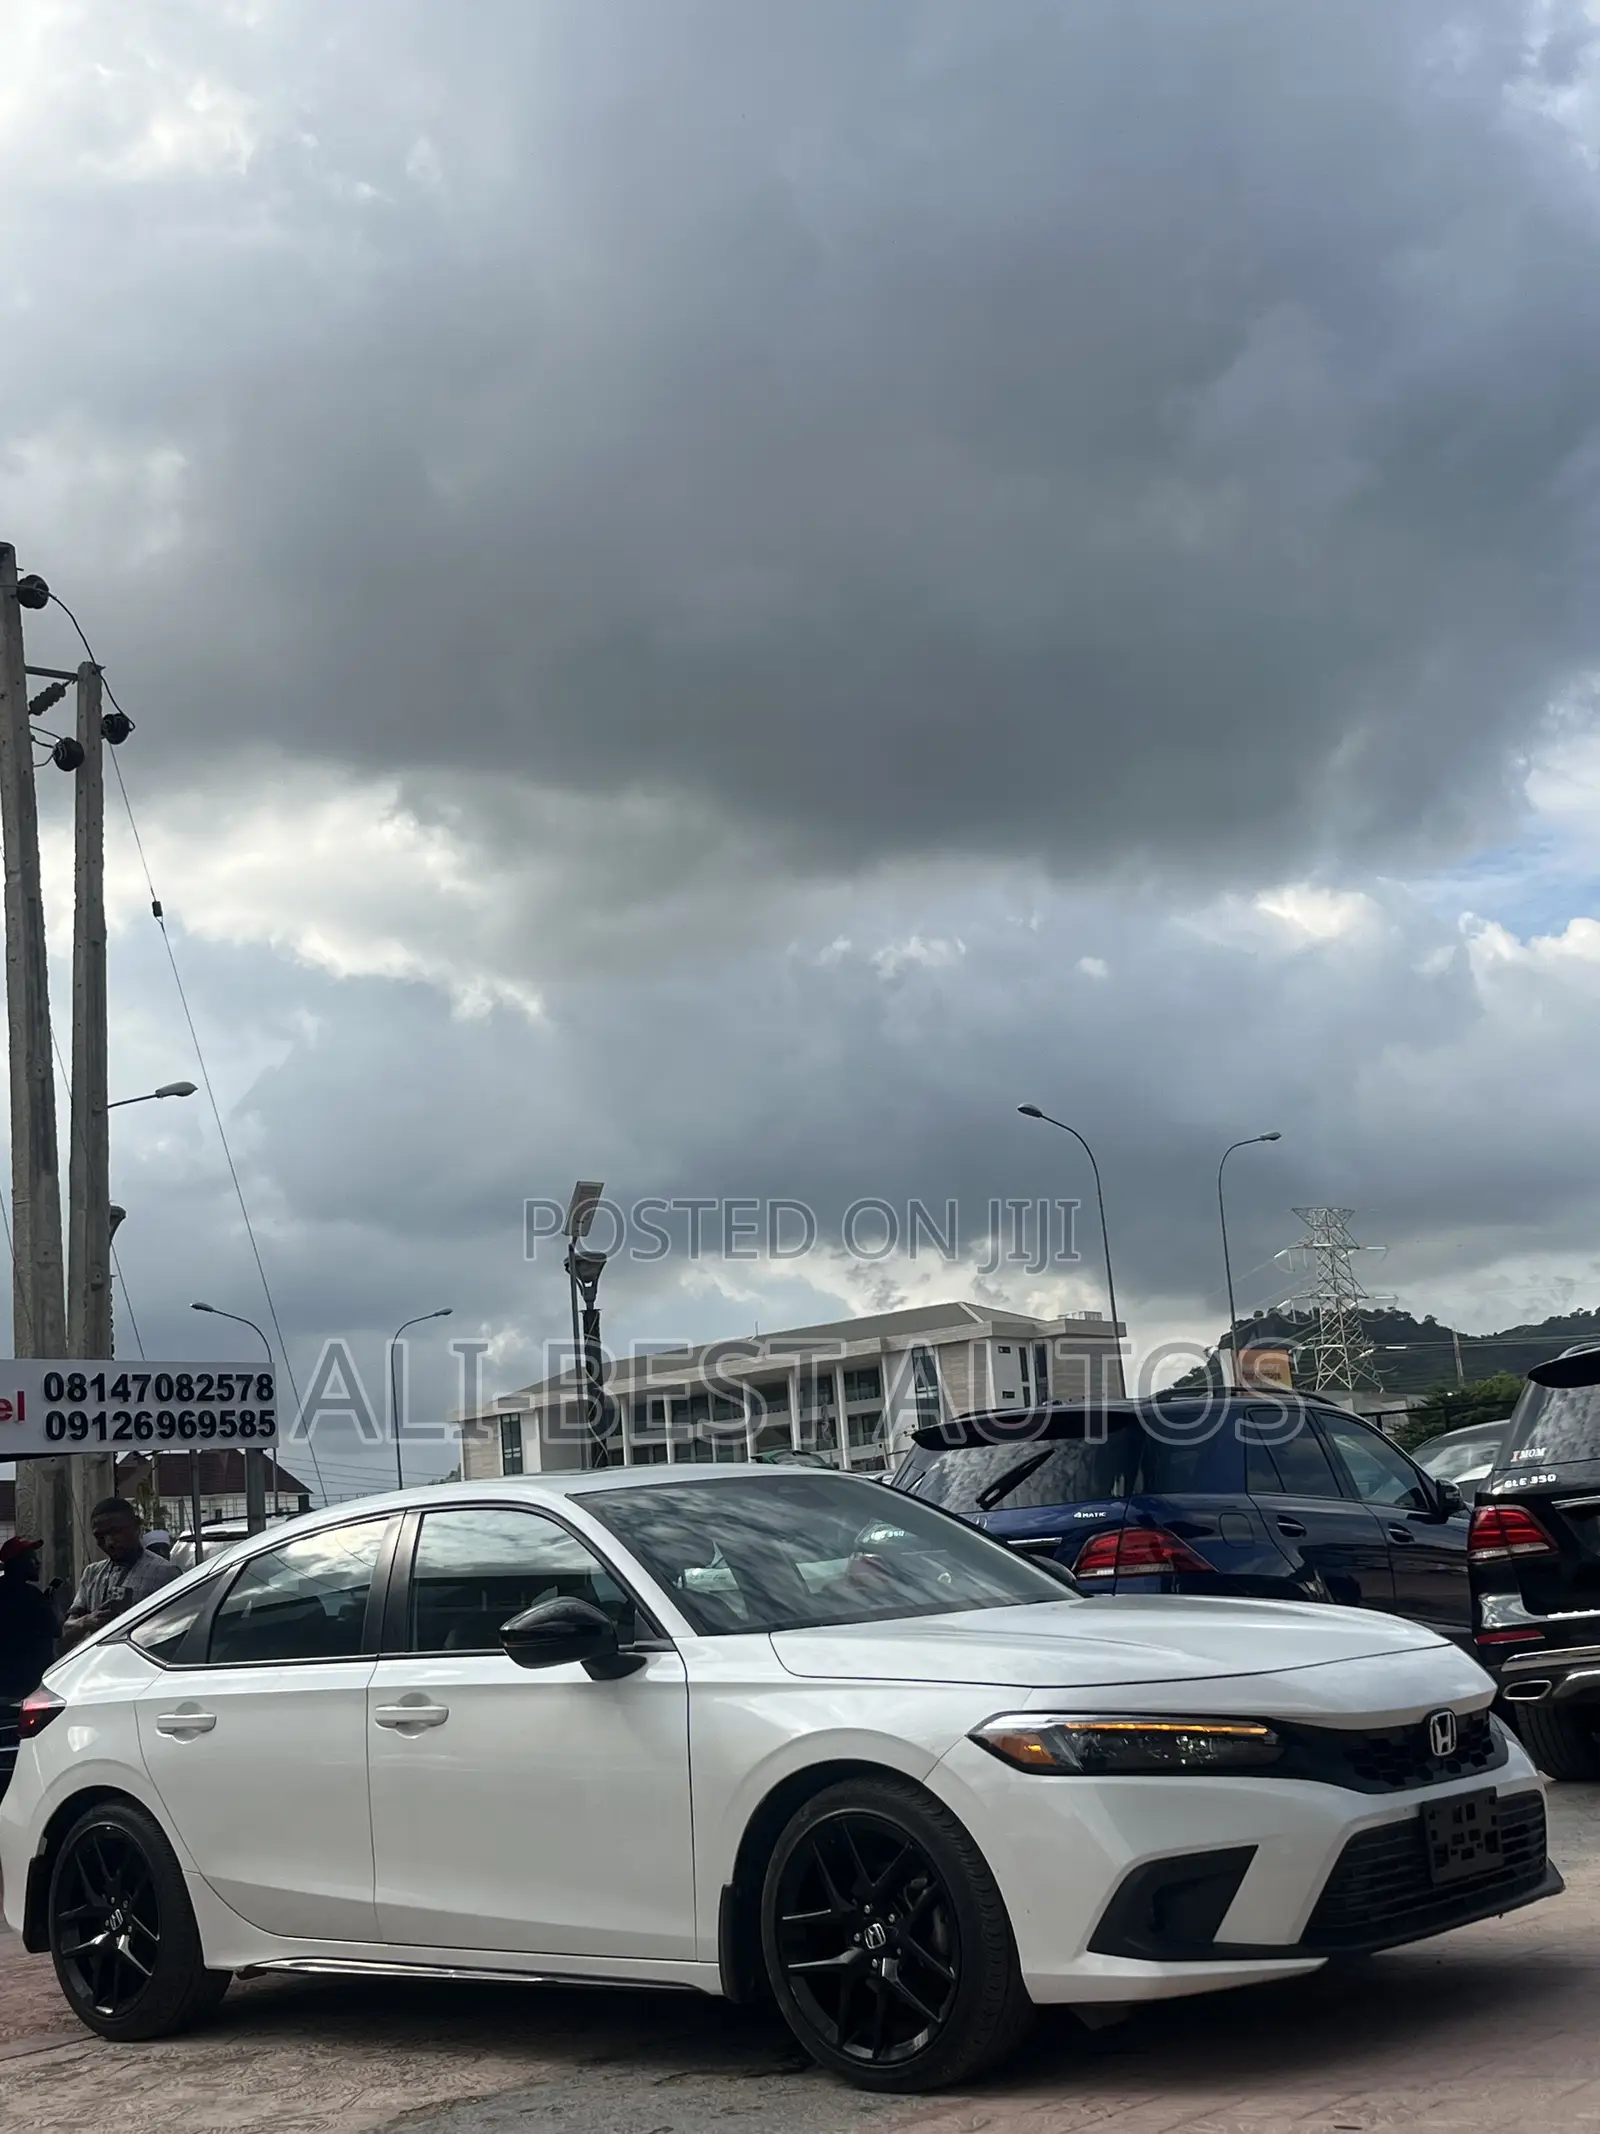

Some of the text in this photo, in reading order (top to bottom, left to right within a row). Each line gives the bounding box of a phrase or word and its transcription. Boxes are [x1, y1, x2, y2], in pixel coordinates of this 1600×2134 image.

[43, 1372, 275, 1402] 08147082578
[45, 1409, 277, 1441] 09126969585
[1504, 1473, 1557, 1488] GLE 350
